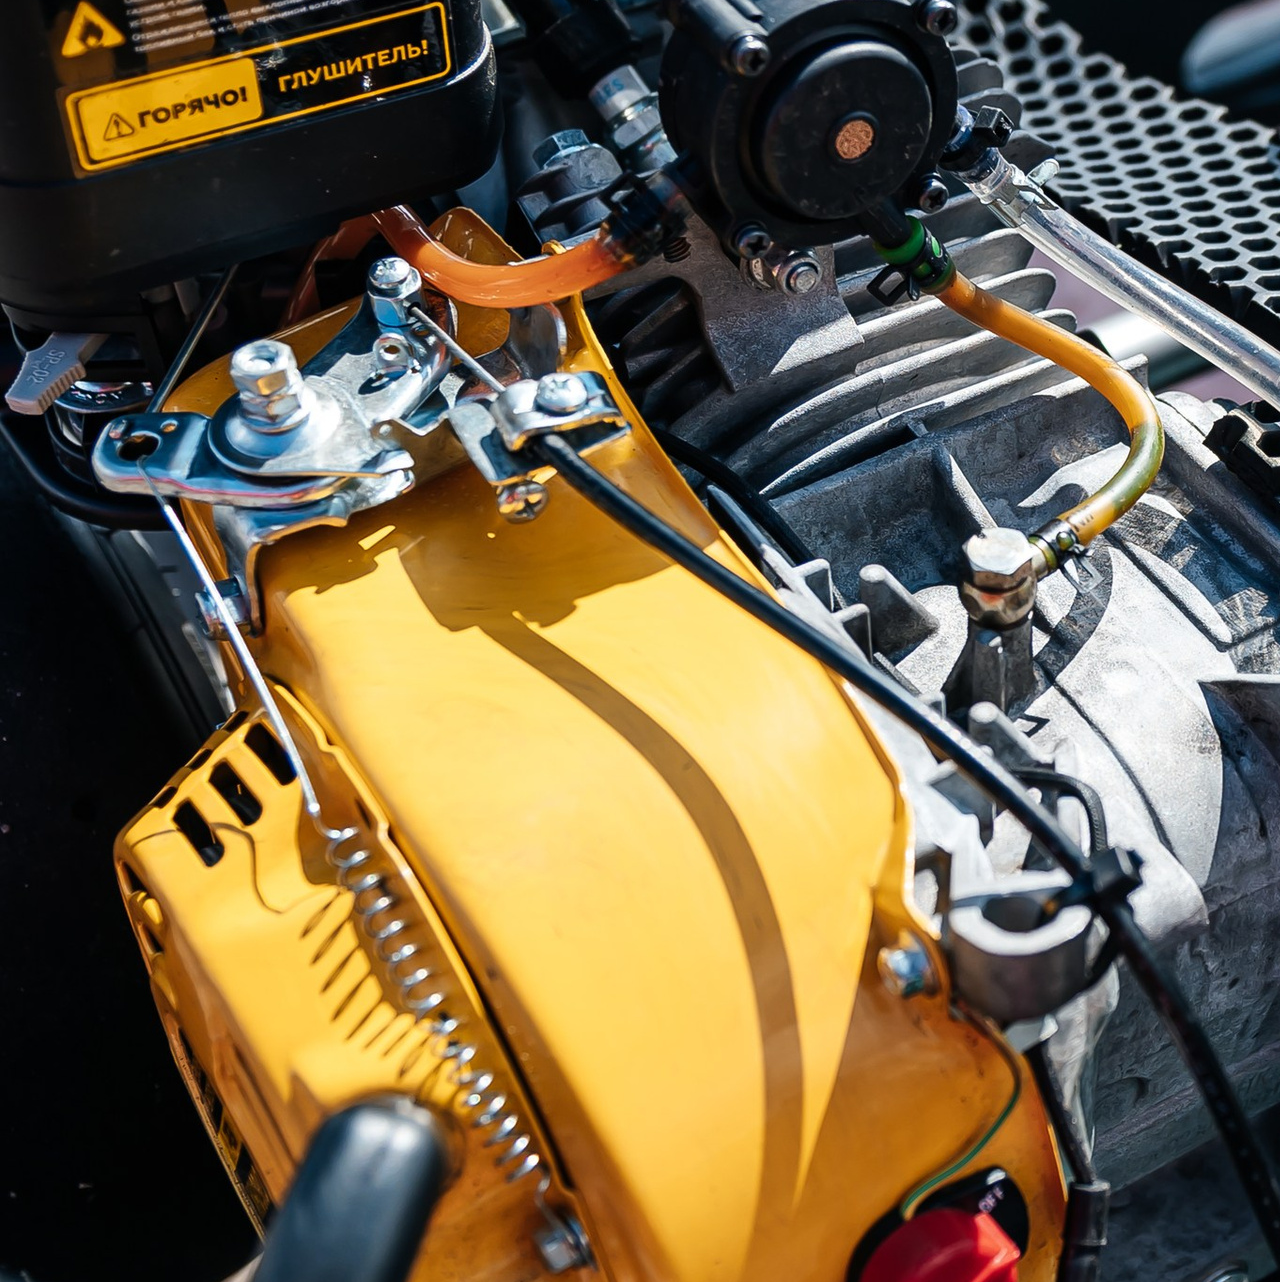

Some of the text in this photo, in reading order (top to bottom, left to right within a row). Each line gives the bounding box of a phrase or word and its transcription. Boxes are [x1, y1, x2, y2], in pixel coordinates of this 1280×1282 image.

[137, 39, 430, 129] ГОРЯЧО! ГЛУШИТЕЛЬ!
[26, 348, 66, 385] SP-02
